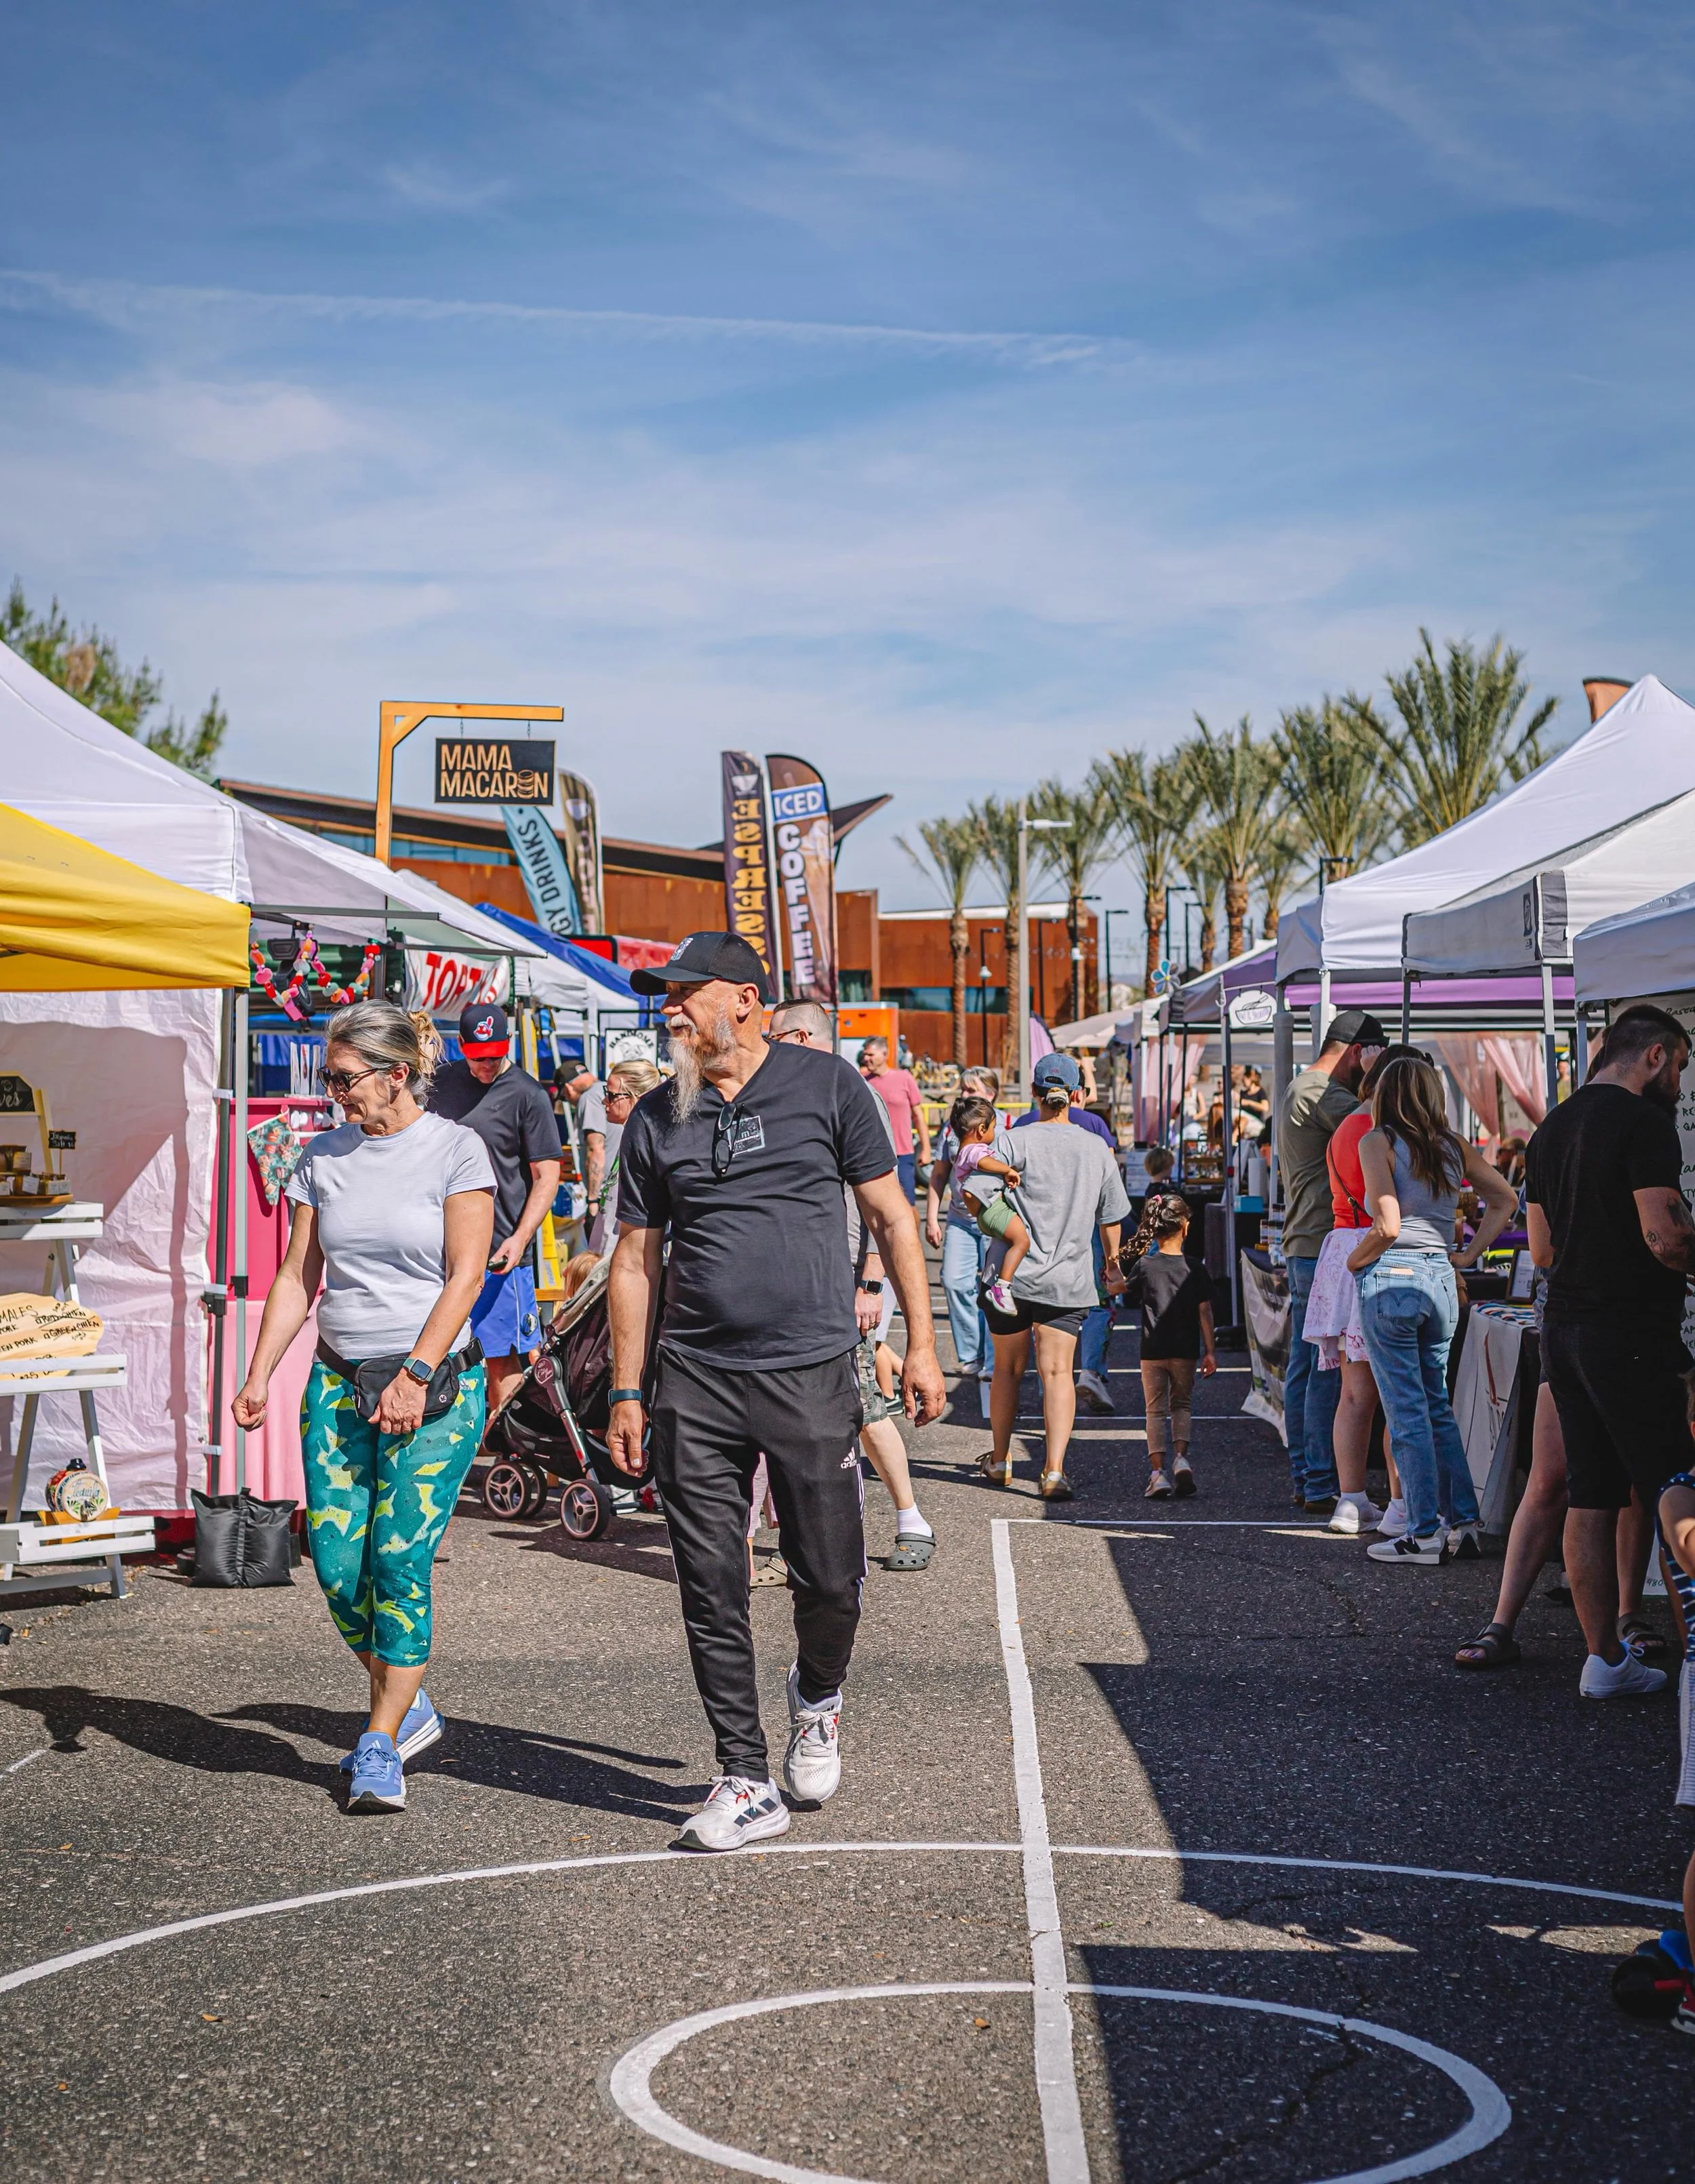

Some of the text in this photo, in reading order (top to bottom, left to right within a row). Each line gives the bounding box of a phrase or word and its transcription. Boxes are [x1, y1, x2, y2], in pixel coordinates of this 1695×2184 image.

[441, 744, 513, 771] MAMA
[775, 791, 822, 815] ICED
[517, 817, 561, 904] DRINKS
[777, 823, 816, 986] COFFEE
[14, 1336, 38, 1348] PORK
